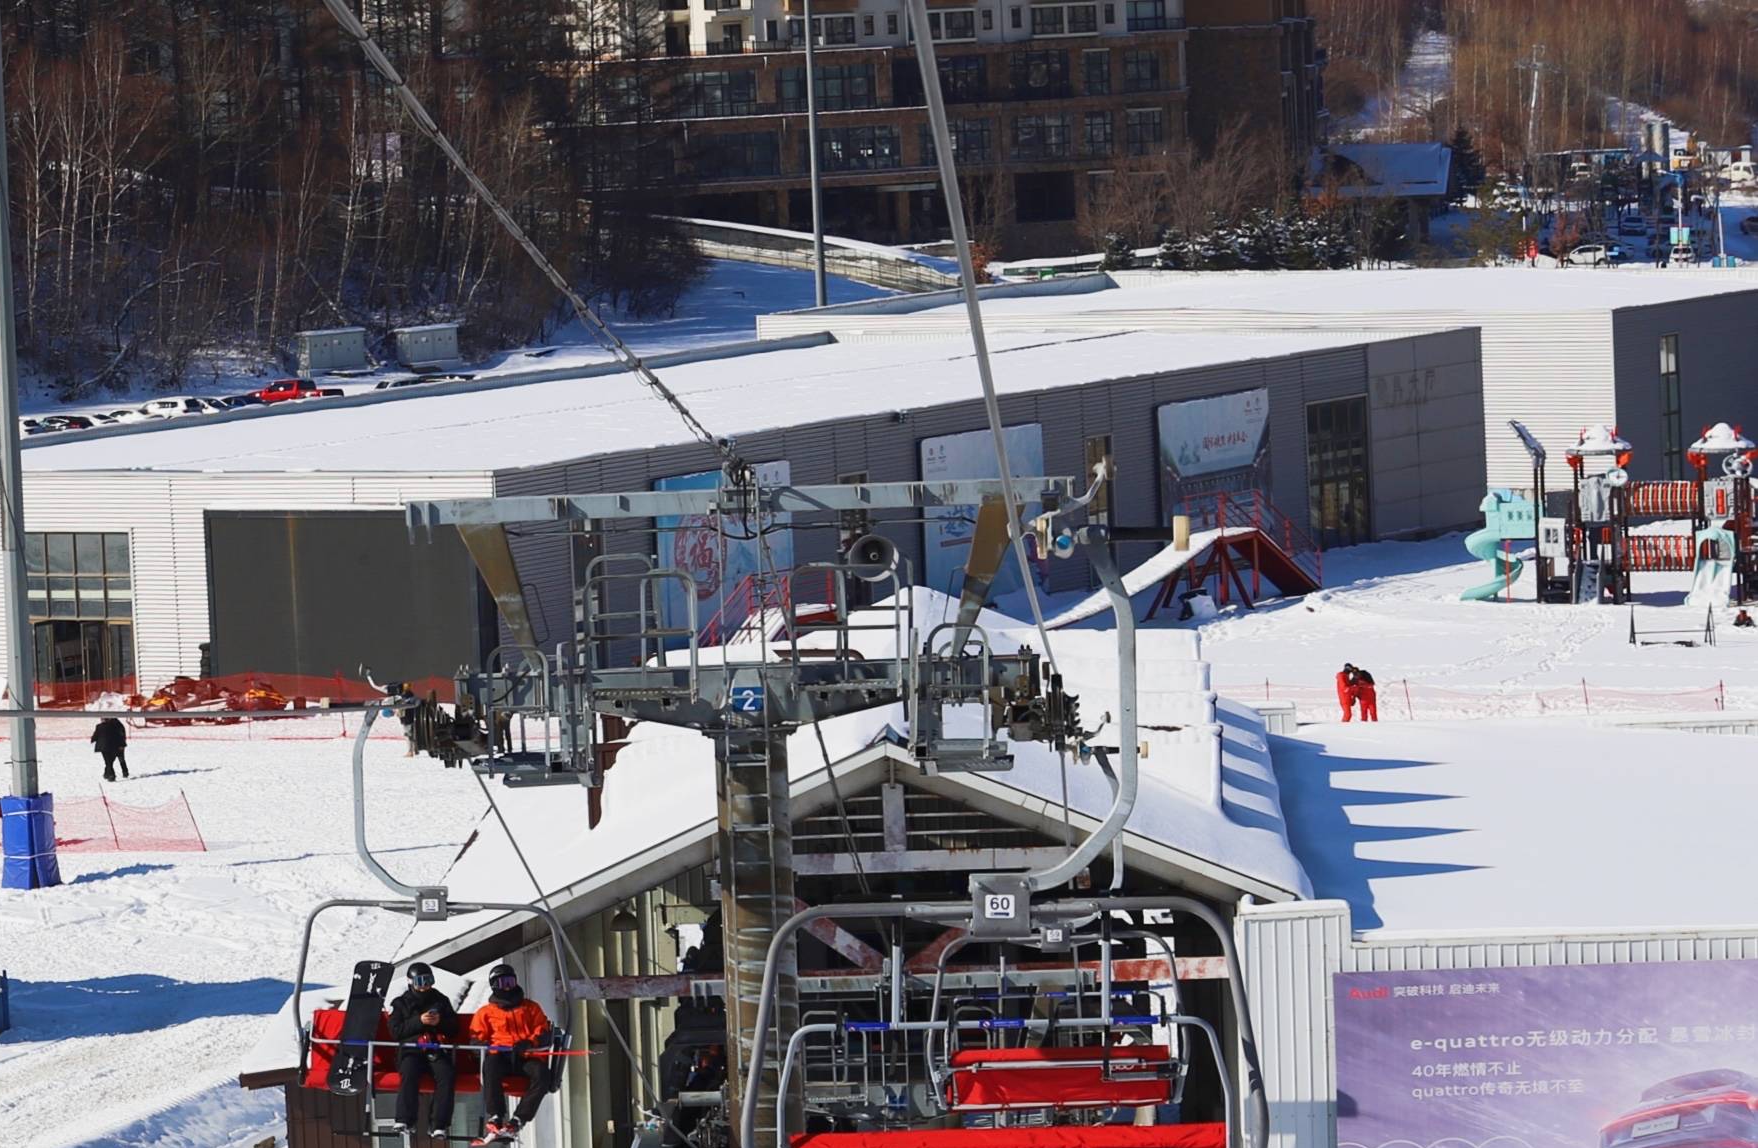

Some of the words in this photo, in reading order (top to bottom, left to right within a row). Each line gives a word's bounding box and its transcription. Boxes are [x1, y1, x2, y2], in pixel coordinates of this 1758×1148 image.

[742, 689, 756, 711] 2
[990, 897, 1010, 910] 60
[1348, 986, 1389, 1000] Audi
[1393, 984, 1445, 998] 突破科技
[1449, 982, 1501, 996] 启迪未来
[1410, 1027, 1659, 1053] e-quattro无级动力分配
[1411, 1060, 1523, 1078] 40年燃情不止
[1411, 1078, 1585, 1100] quattro传奇无境不至
